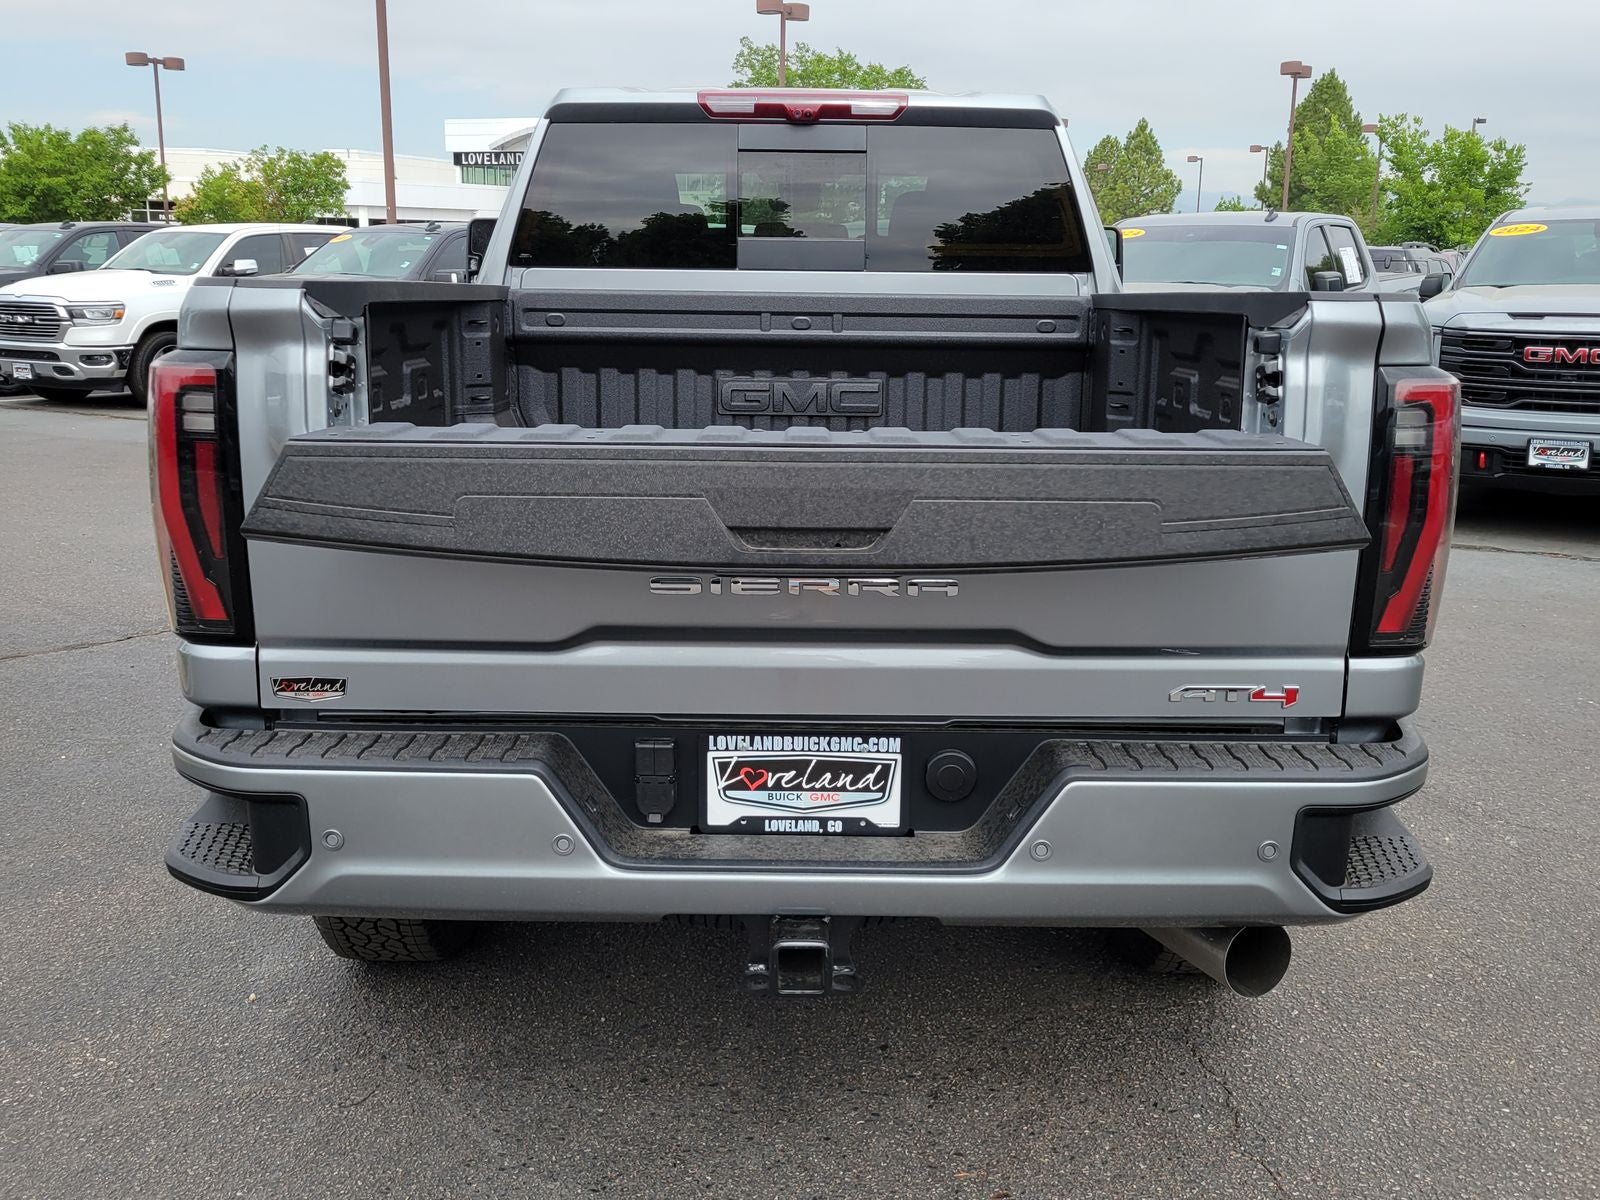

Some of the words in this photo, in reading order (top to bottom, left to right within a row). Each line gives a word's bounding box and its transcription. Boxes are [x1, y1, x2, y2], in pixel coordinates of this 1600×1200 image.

[461, 152, 523, 165] LOVELAND
[1494, 225, 1543, 234] 2024
[721, 381, 880, 413] GMC
[650, 576, 960, 597] SIERRA
[273, 677, 344, 692] Loveland
[1169, 685, 1300, 709] AT4
[708, 735, 901, 753] LOVELANDBUICKGMCCOM
[718, 756, 885, 791] Loveland
[767, 792, 803, 801] BUICK
[809, 793, 840, 802] GMC
[764, 820, 824, 833] LOVELAND,
[827, 821, 843, 832] CO
